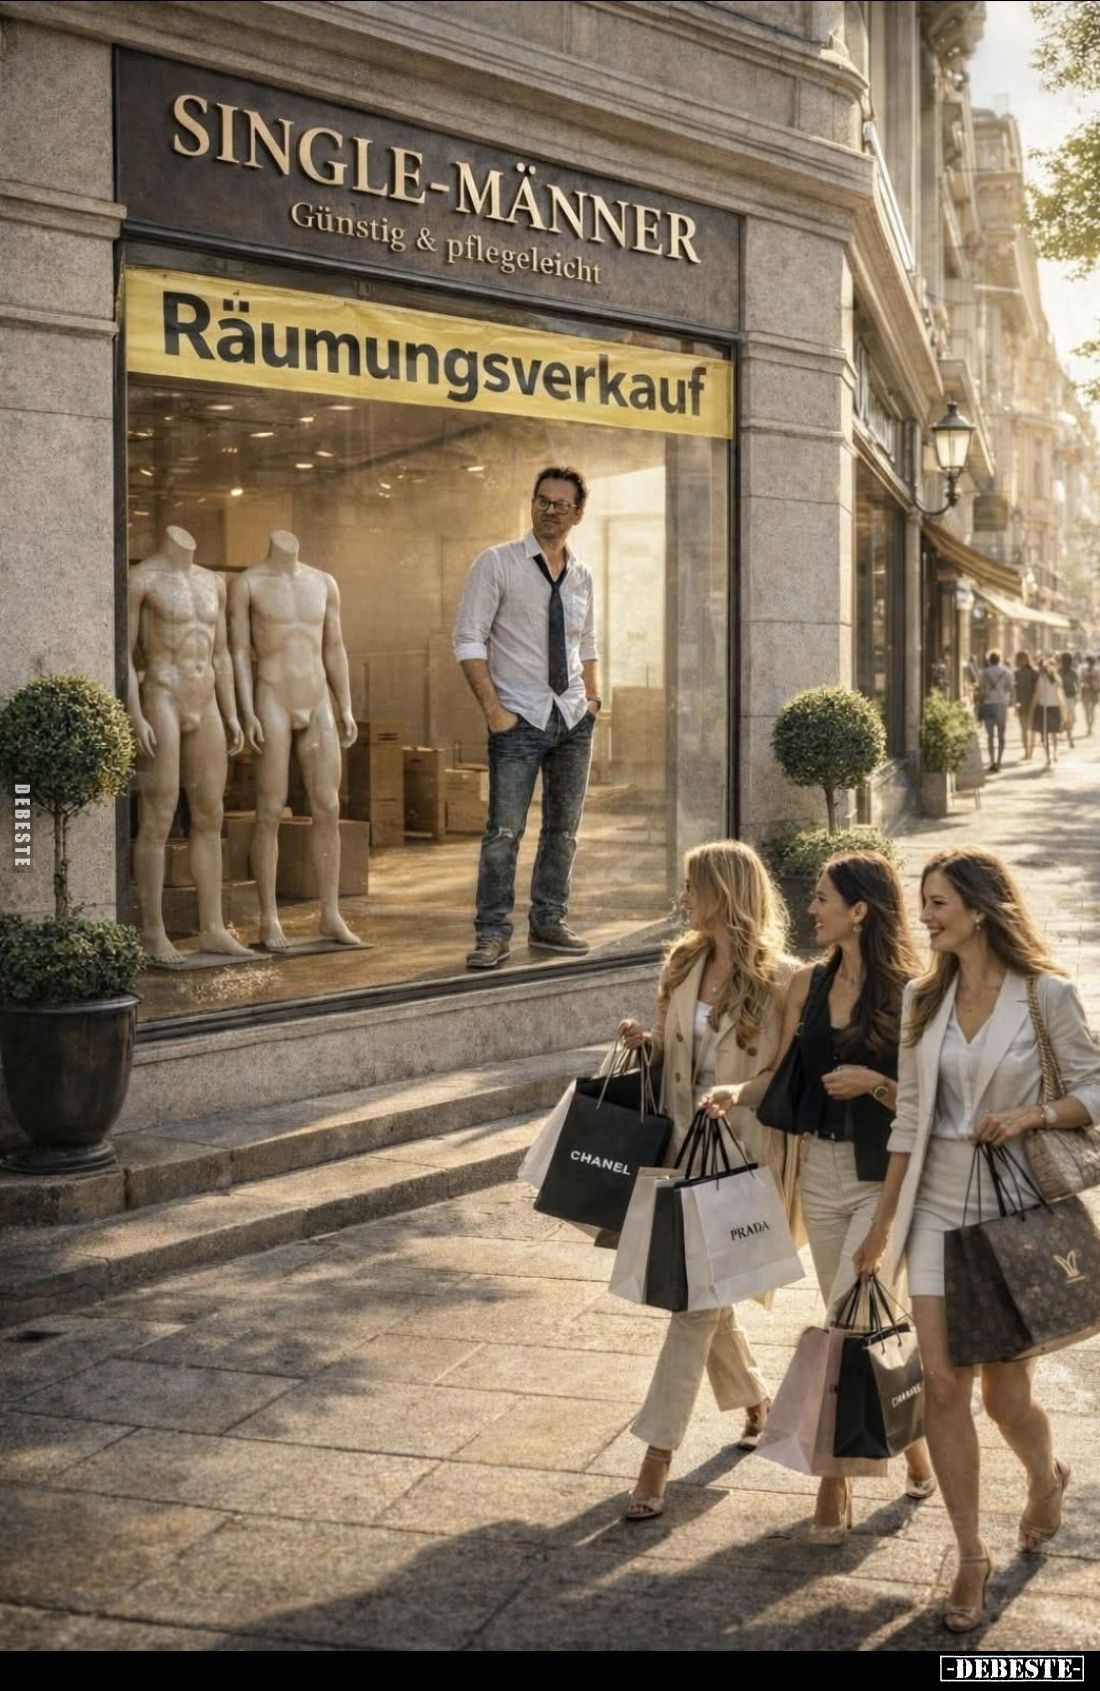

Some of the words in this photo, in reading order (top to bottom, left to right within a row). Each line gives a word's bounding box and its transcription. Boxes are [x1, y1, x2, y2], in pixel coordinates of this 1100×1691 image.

[172, 94, 701, 264] SINGLE-MÄNNER
[291, 202, 406, 252] Günstig
[416, 227, 437, 251] &
[447, 234, 602, 285] pflegeleicht
[163, 291, 705, 416] Räumungsverkauf
[570, 1150, 631, 1176] CHANEL
[730, 1220, 770, 1241] PRADA
